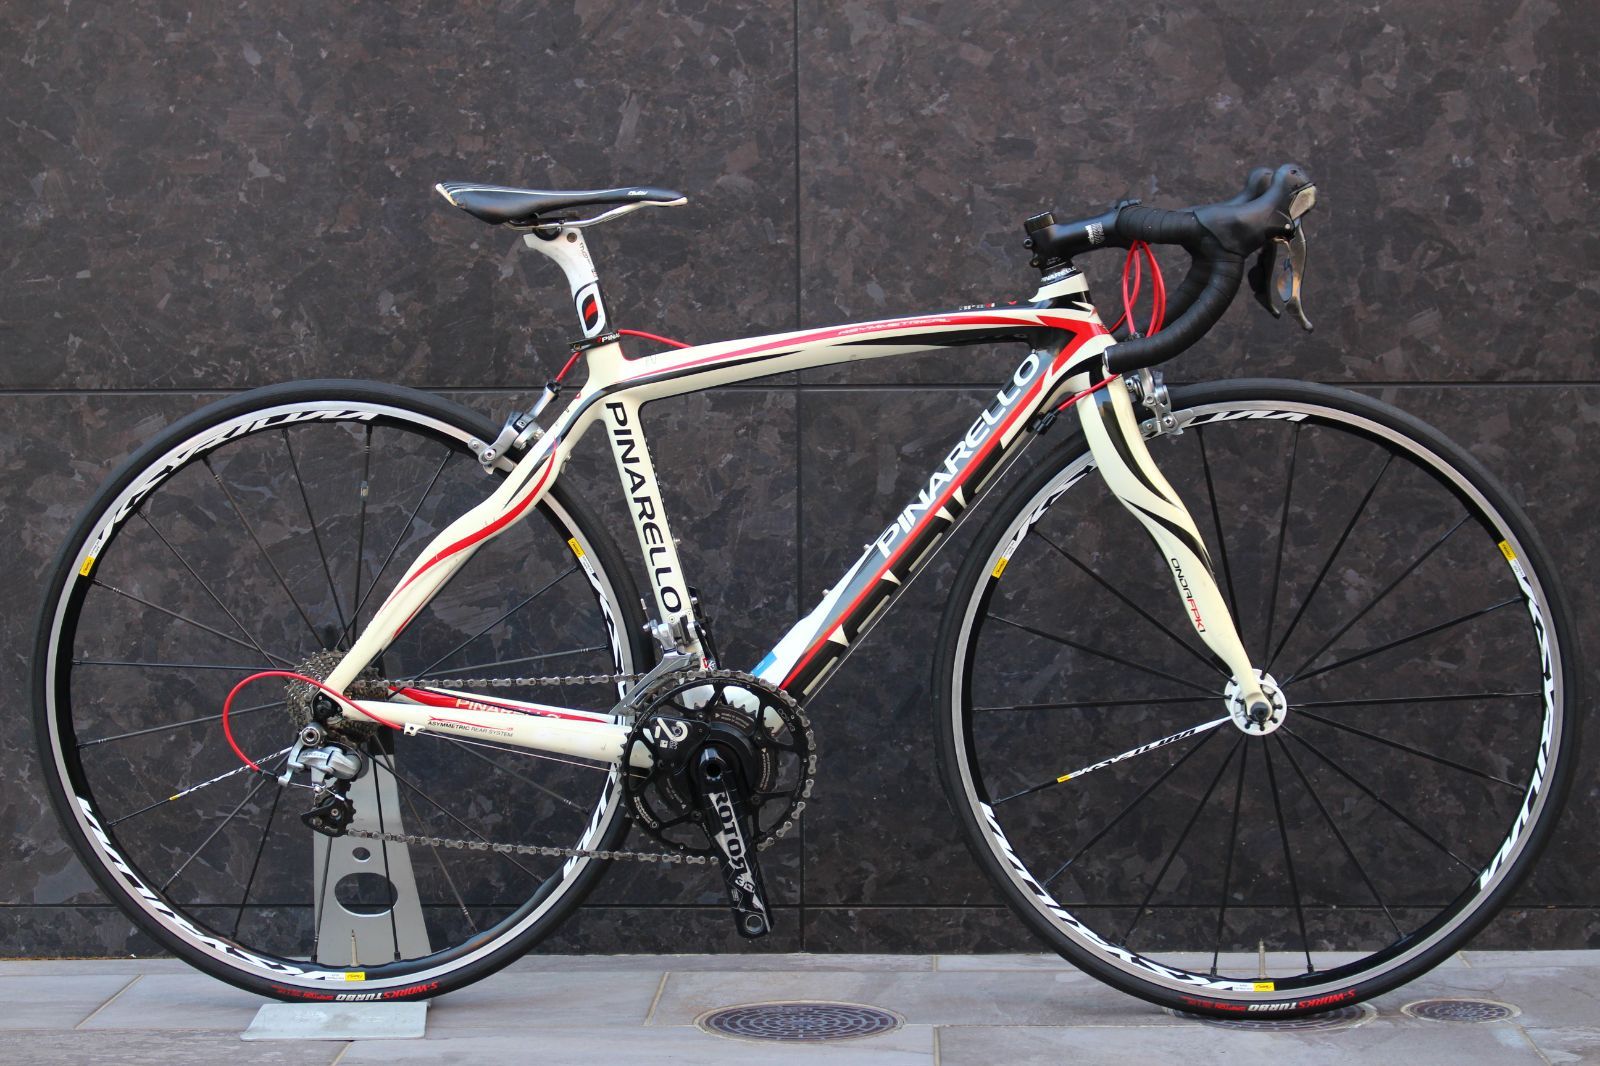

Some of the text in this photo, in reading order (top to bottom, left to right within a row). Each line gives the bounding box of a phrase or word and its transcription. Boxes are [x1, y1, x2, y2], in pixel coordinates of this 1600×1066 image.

[877, 353, 1039, 559] PINARELLO
[606, 401, 682, 613] PINARELLO
[427, 720, 513, 738] ASYMMETRIC REAR SYSTEM
[335, 990, 382, 1002] TURBO
[1248, 1002, 1298, 1011] TURBO
